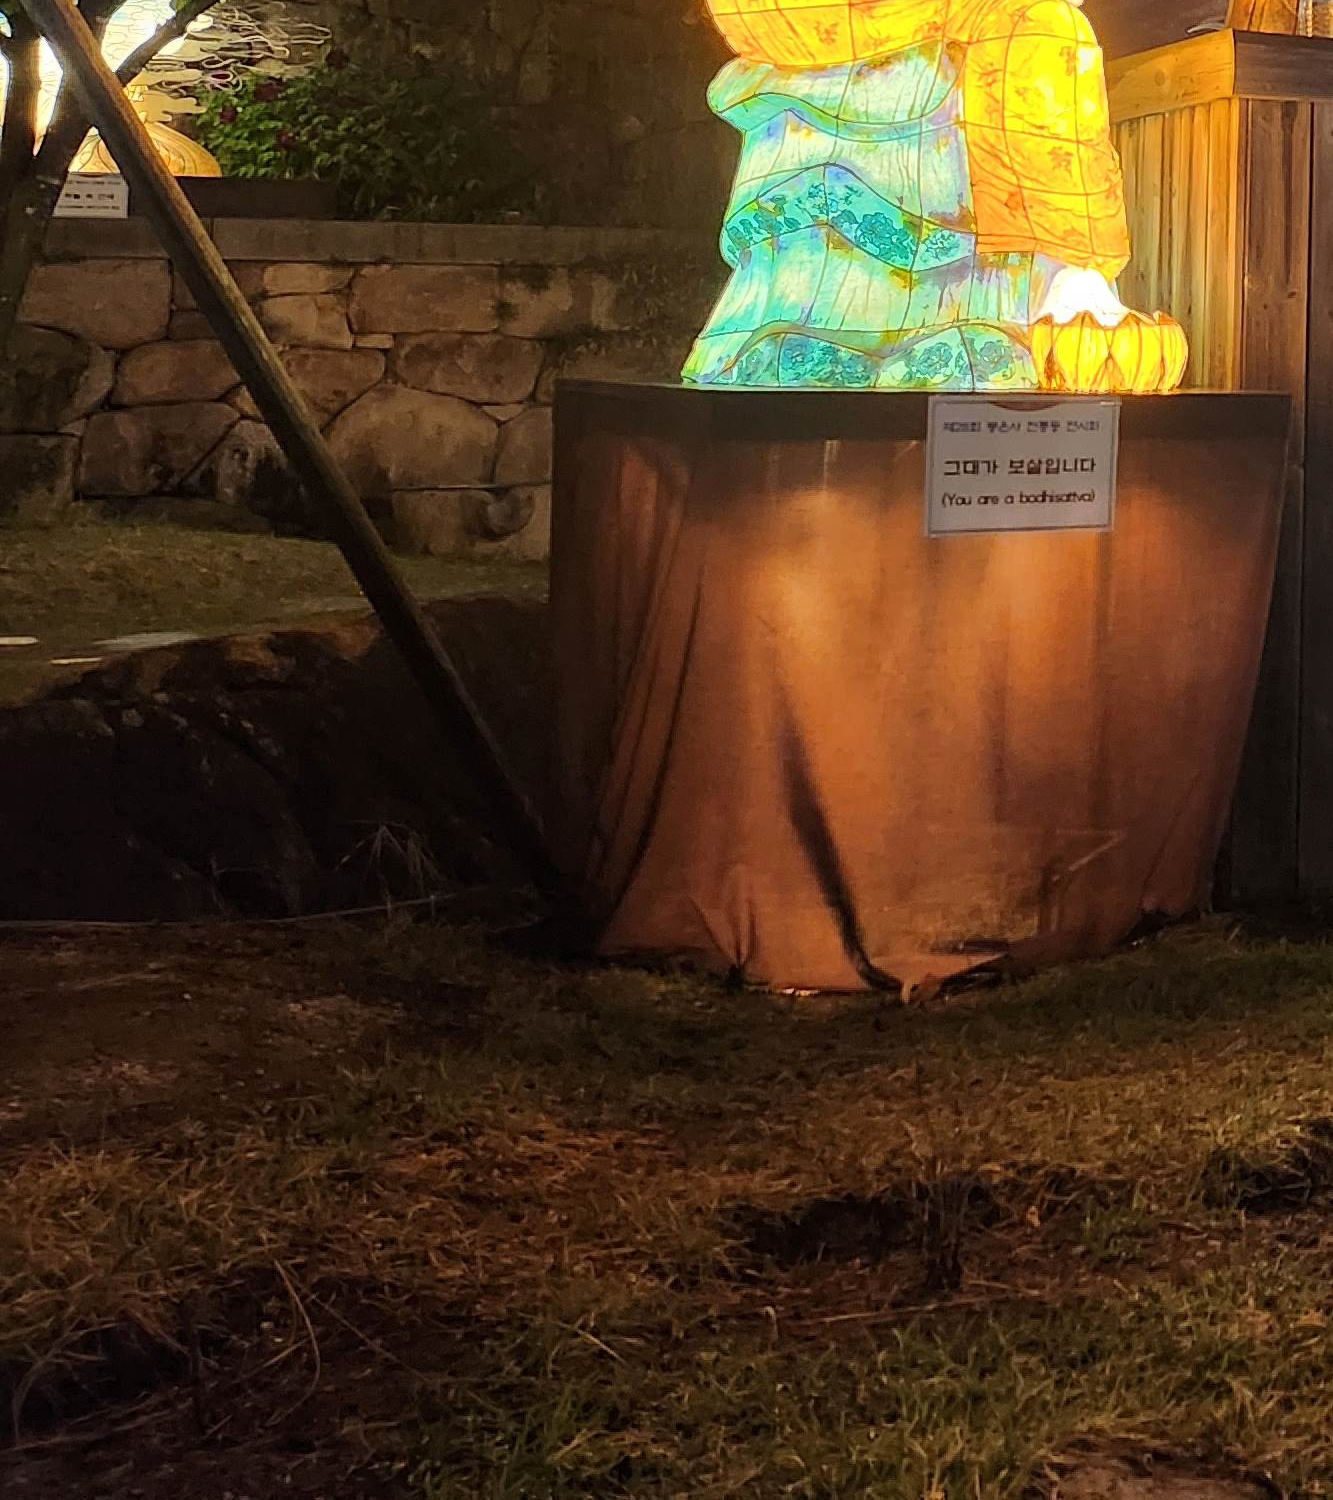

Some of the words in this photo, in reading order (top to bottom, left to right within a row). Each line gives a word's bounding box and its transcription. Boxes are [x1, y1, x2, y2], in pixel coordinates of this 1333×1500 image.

[943, 458, 999, 476] 그대가
[1007, 457, 1097, 476] 보살입니다
[941, 491, 972, 508] (You
[977, 494, 999, 505] are
[1004, 494, 1015, 505] a
